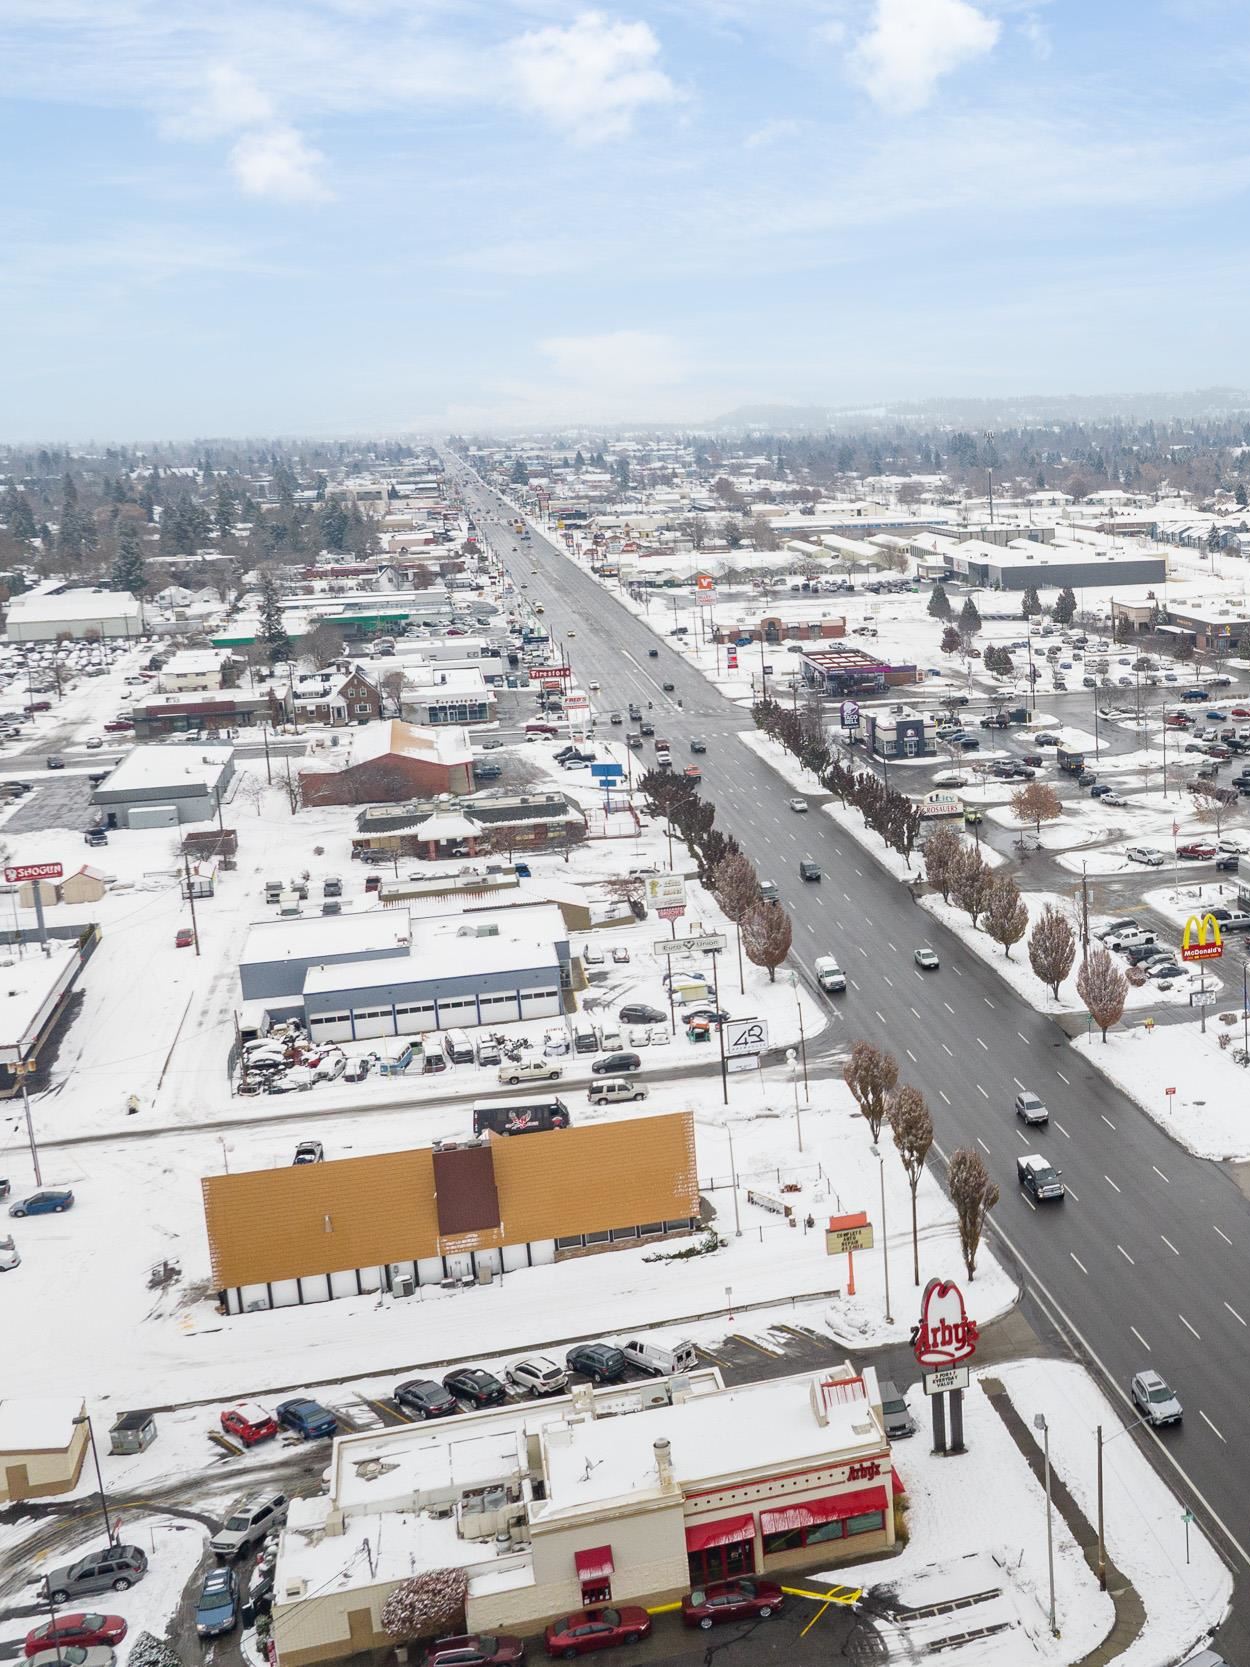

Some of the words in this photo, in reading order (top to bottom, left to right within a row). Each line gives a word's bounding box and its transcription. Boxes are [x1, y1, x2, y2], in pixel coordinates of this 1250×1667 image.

[17, 864, 61, 877] SHOGUN
[1184, 946, 1222, 957] McDonald's
[836, 1229, 862, 1238] COMPLETE
[914, 1311, 980, 1353] Arby's
[932, 1375, 958, 1384] EVERYDAY
[847, 1461, 881, 1481] Arby's
